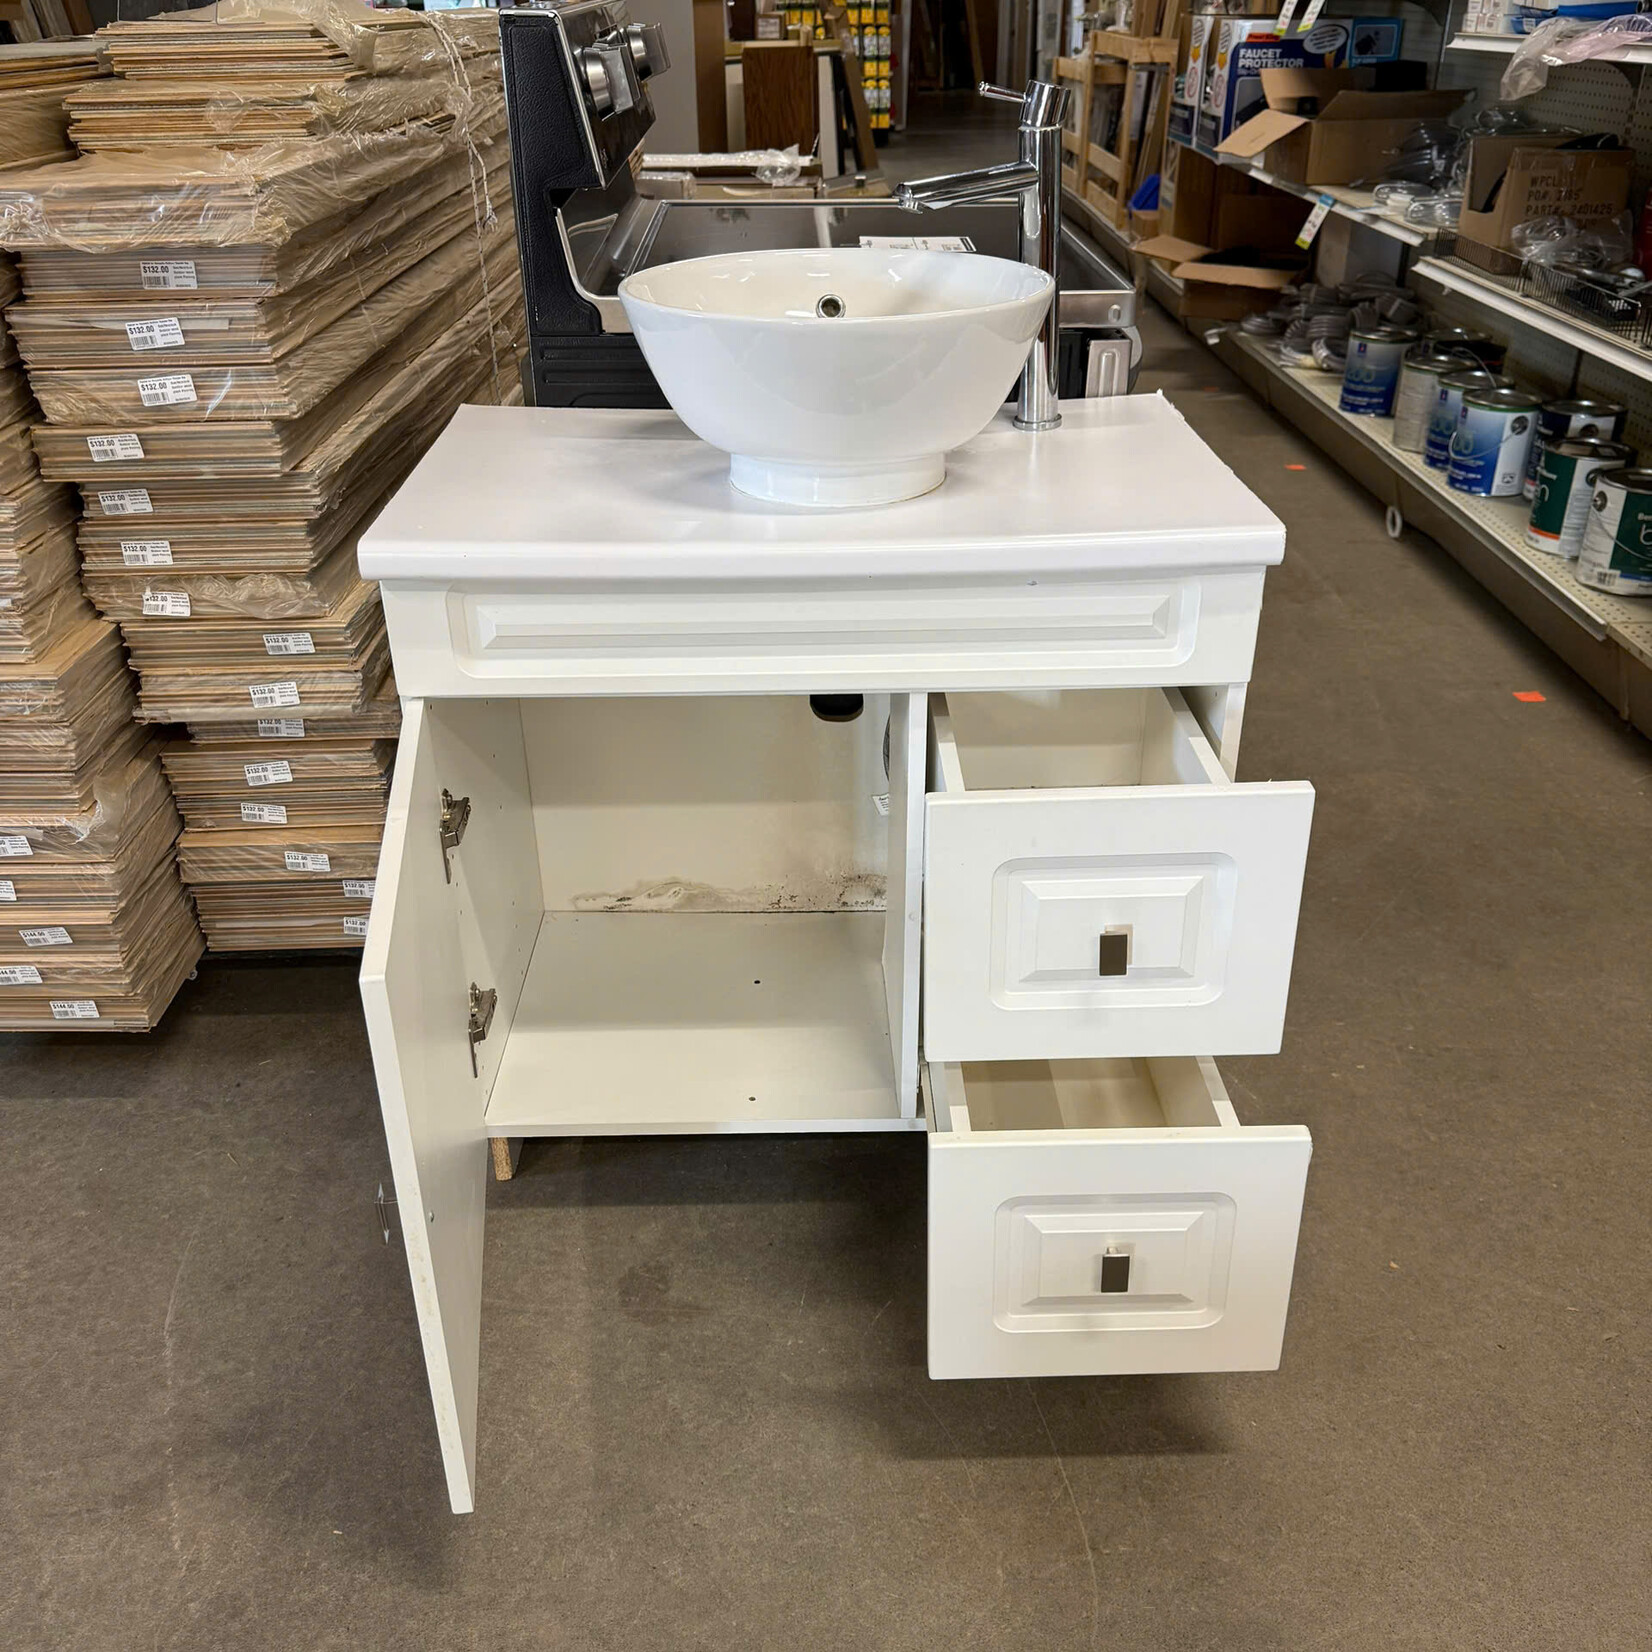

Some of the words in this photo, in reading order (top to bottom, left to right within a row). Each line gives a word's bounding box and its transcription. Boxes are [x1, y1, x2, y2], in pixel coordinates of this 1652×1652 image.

[1238, 48, 1282, 58] FAUCET
[1238, 58, 1304, 68] PROTECTOR
[143, 266, 169, 274] $132.00
[129, 325, 154, 335] $132.00
[141, 382, 167, 392] $132.00
[90, 440, 115, 448] $132.00
[102, 494, 126, 502] $132.00
[252, 688, 274, 696] $132.00
[246, 766, 268, 774] $132.00
